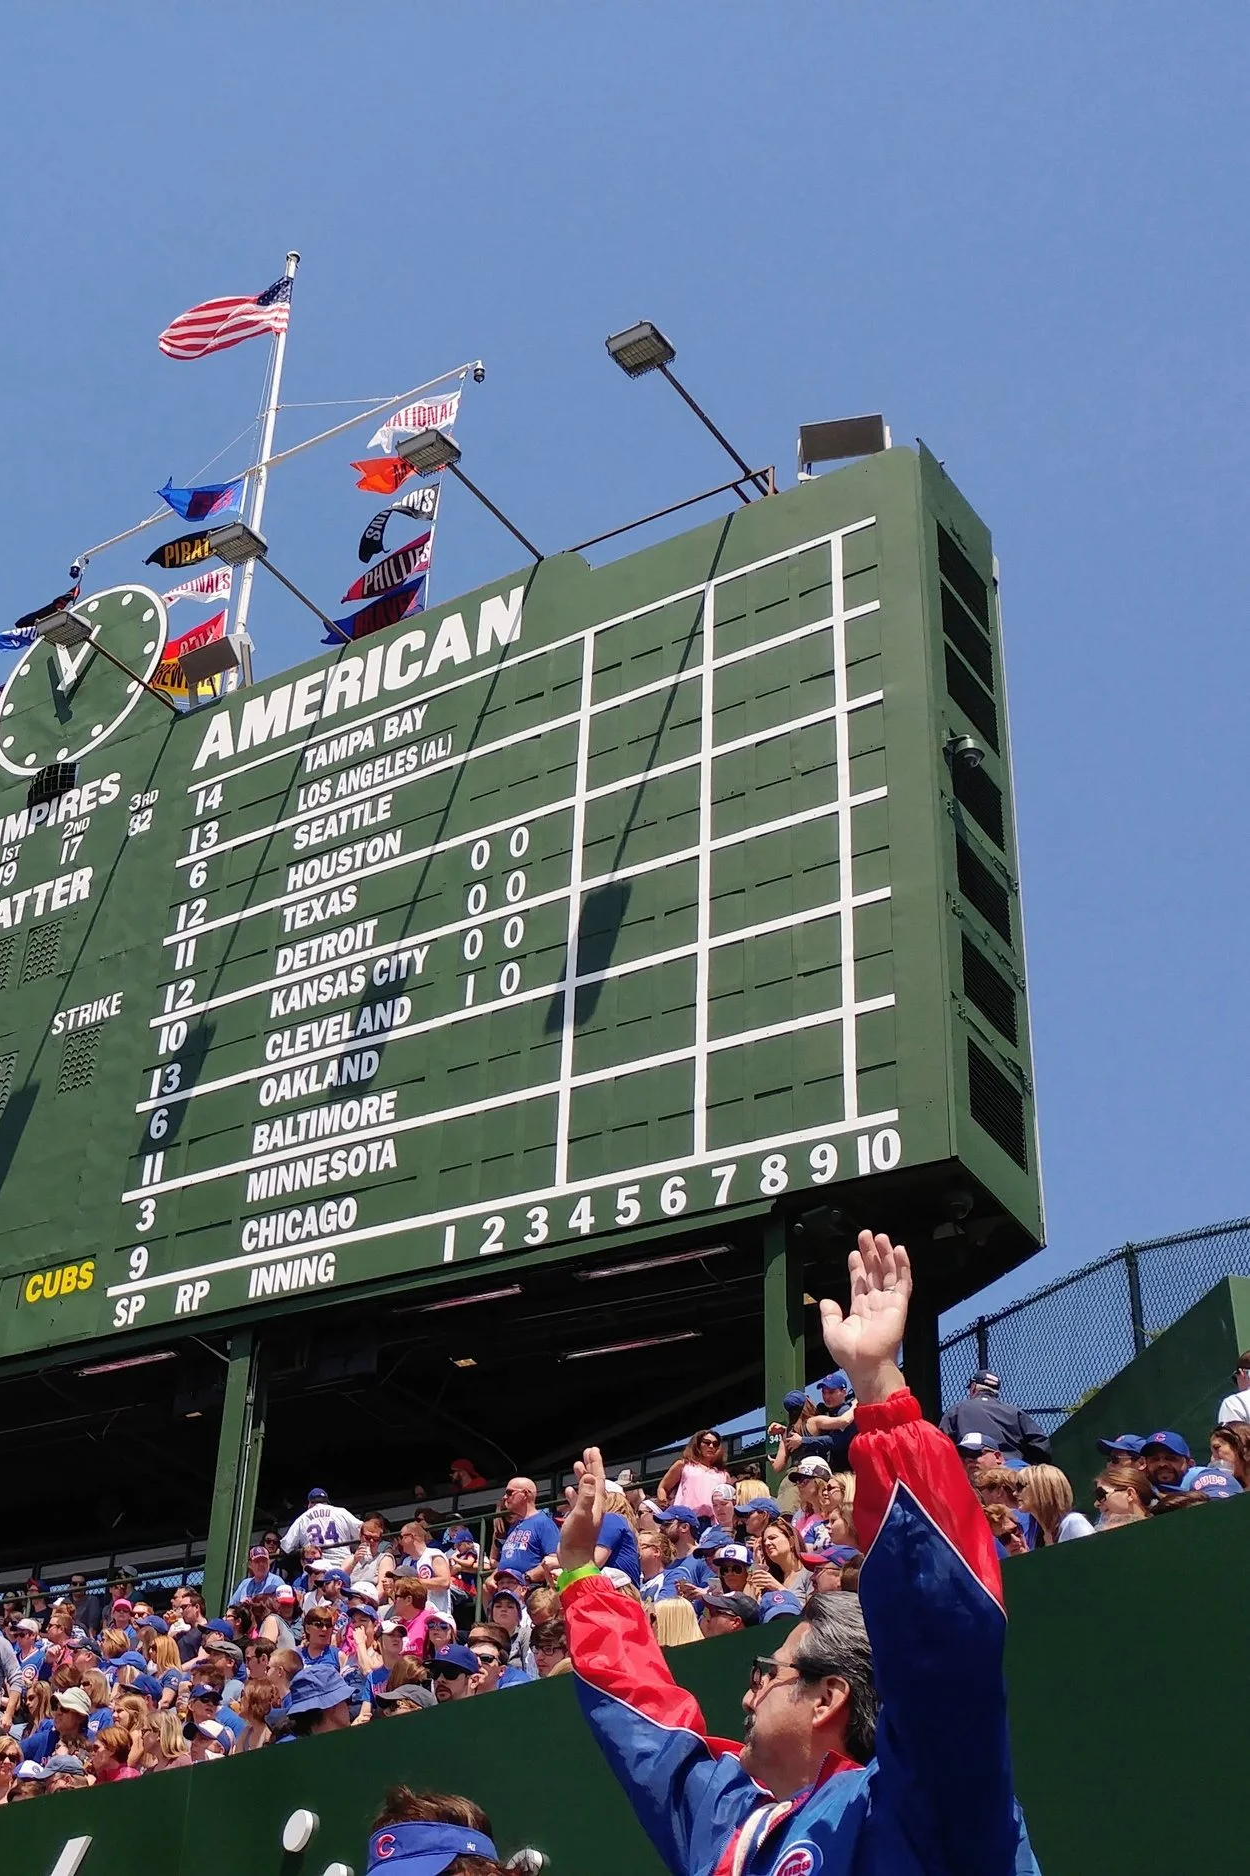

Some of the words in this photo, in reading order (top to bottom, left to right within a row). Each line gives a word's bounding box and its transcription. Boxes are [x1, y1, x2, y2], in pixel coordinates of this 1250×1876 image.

[384, 404, 455, 428] NATIONAL
[165, 537, 212, 568] PIRAT
[363, 545, 430, 595] PHILLIES
[193, 585, 524, 770] AMERICAN
[129, 790, 159, 811] 3RD
[189, 821, 220, 854] 13
[297, 779, 332, 812] LOS
[334, 746, 418, 798] ANGELES
[421, 733, 452, 765] (AL)
[195, 783, 223, 816] 14
[305, 725, 375, 773] TAMPA
[383, 704, 428, 743] BAY
[1, 844, 22, 863] 1ST
[60, 835, 83, 865] 17
[62, 817, 90, 840] 2ND
[128, 809, 153, 836] 82
[190, 861, 207, 888] 6
[293, 794, 393, 850] SEATTLE
[175, 938, 196, 970] 11
[283, 885, 357, 932] TEXAS
[471, 840, 490, 870] 0
[510, 827, 529, 857] 0
[177, 898, 207, 932] 12
[287, 829, 402, 892] HOUSTON
[164, 979, 195, 1013] 12
[276, 919, 378, 975] DETROIT
[468, 884, 486, 915] 0
[506, 871, 525, 902] 0
[52, 992, 123, 1035] STRIKE
[158, 1021, 187, 1055] 10
[270, 965, 366, 1018] KANSAS
[373, 945, 430, 985] CITY
[464, 929, 483, 960] 0
[504, 916, 524, 948] 0
[150, 1064, 181, 1098] 13
[266, 996, 411, 1061] CLEVELAND
[465, 974, 475, 1007] 1
[500, 962, 520, 995] 0
[151, 1109, 168, 1138] 6
[259, 1051, 379, 1106] OAKLAND
[142, 1152, 164, 1186] 11
[252, 1091, 397, 1154] BALTIMORE
[136, 1199, 156, 1231] 3
[246, 1139, 397, 1202] MINNESOTA
[113, 1295, 145, 1327] SP
[175, 1280, 210, 1314] RP
[248, 1253, 335, 1298] INNING
[444, 1225, 455, 1263] 1
[480, 1216, 505, 1255] 2
[524, 1207, 548, 1245] 3
[569, 1196, 595, 1235] 4
[615, 1185, 640, 1226] 5
[660, 1176, 686, 1216] 6
[712, 1164, 736, 1206] 7
[760, 1154, 788, 1195] 8
[810, 1143, 838, 1184] 9
[857, 1129, 901, 1175] 10
[129, 1247, 148, 1280] 9
[242, 1197, 357, 1251] CHICAGO
[25, 1260, 95, 1302] CUBS
[306, 1509, 331, 1521] WOOD
[375, 1834, 397, 1860] C
